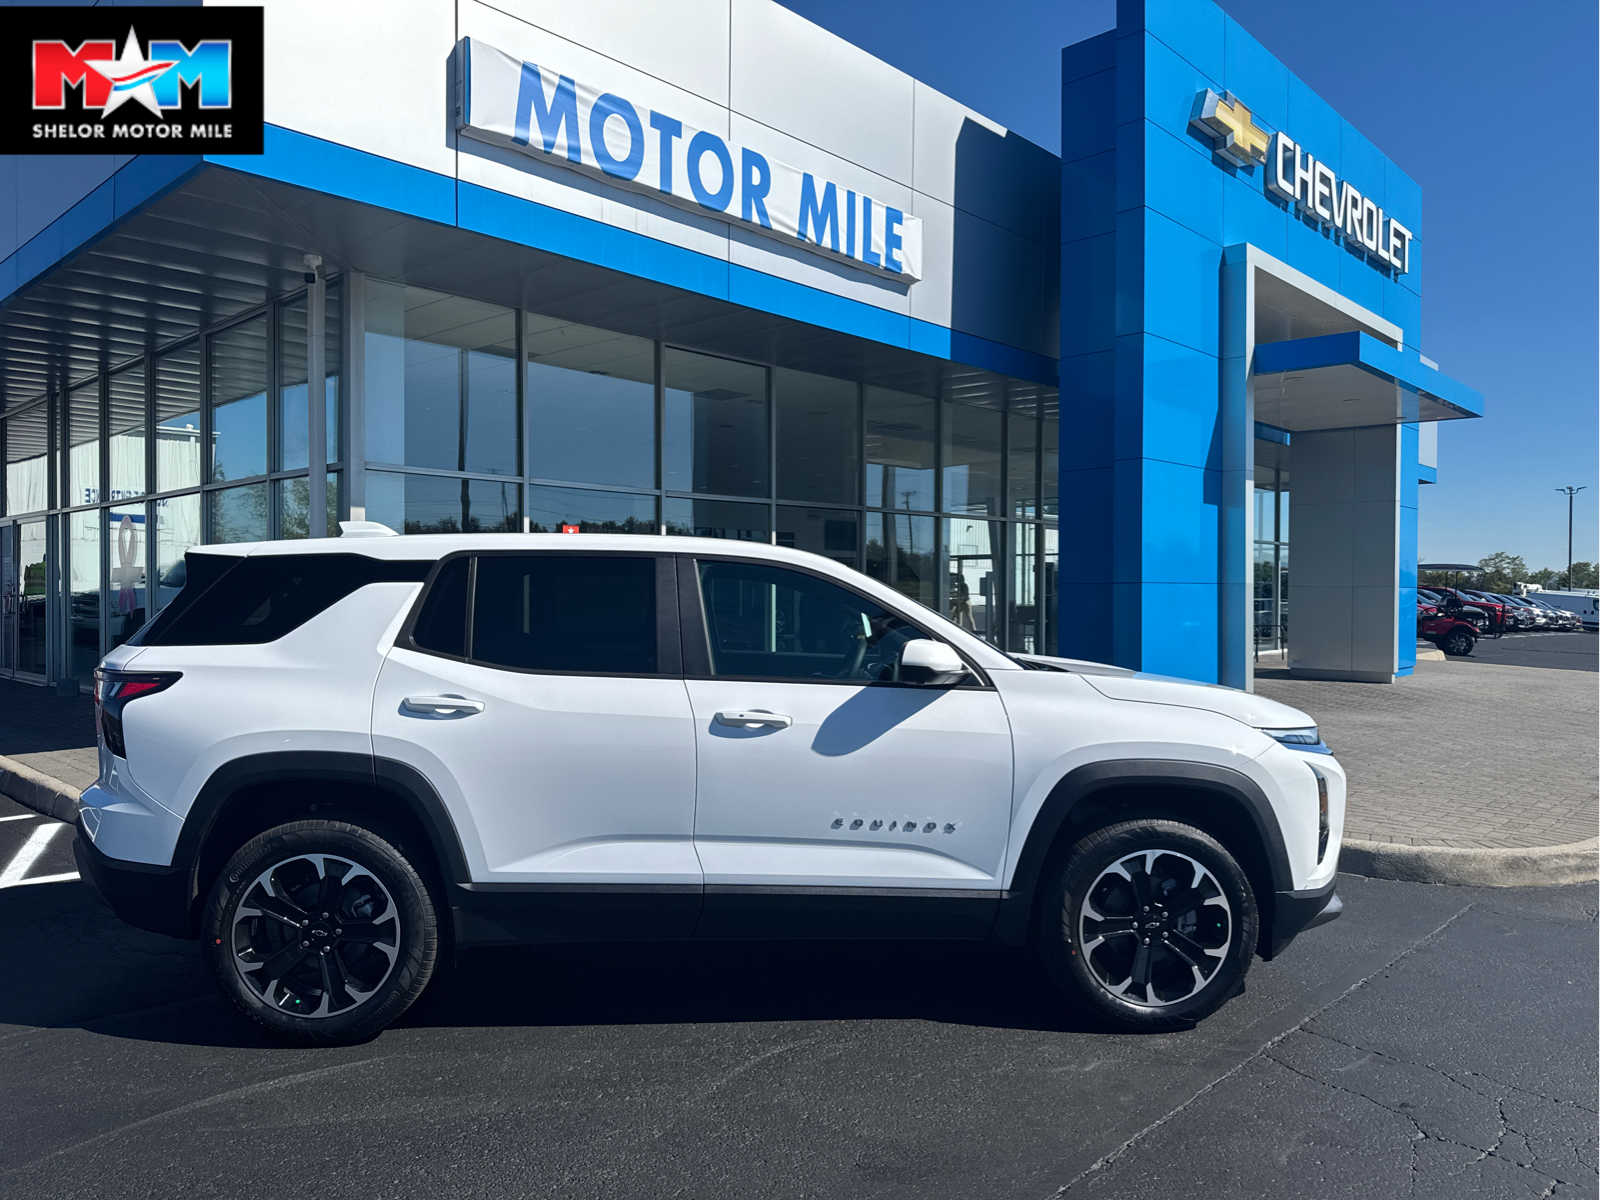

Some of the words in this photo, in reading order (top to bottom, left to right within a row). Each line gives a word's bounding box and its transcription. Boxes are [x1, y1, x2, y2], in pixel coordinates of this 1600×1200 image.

[511, 60, 773, 231] MOTOR
[797, 172, 904, 273] MILE
[1276, 131, 1413, 274] CHEVROLET
